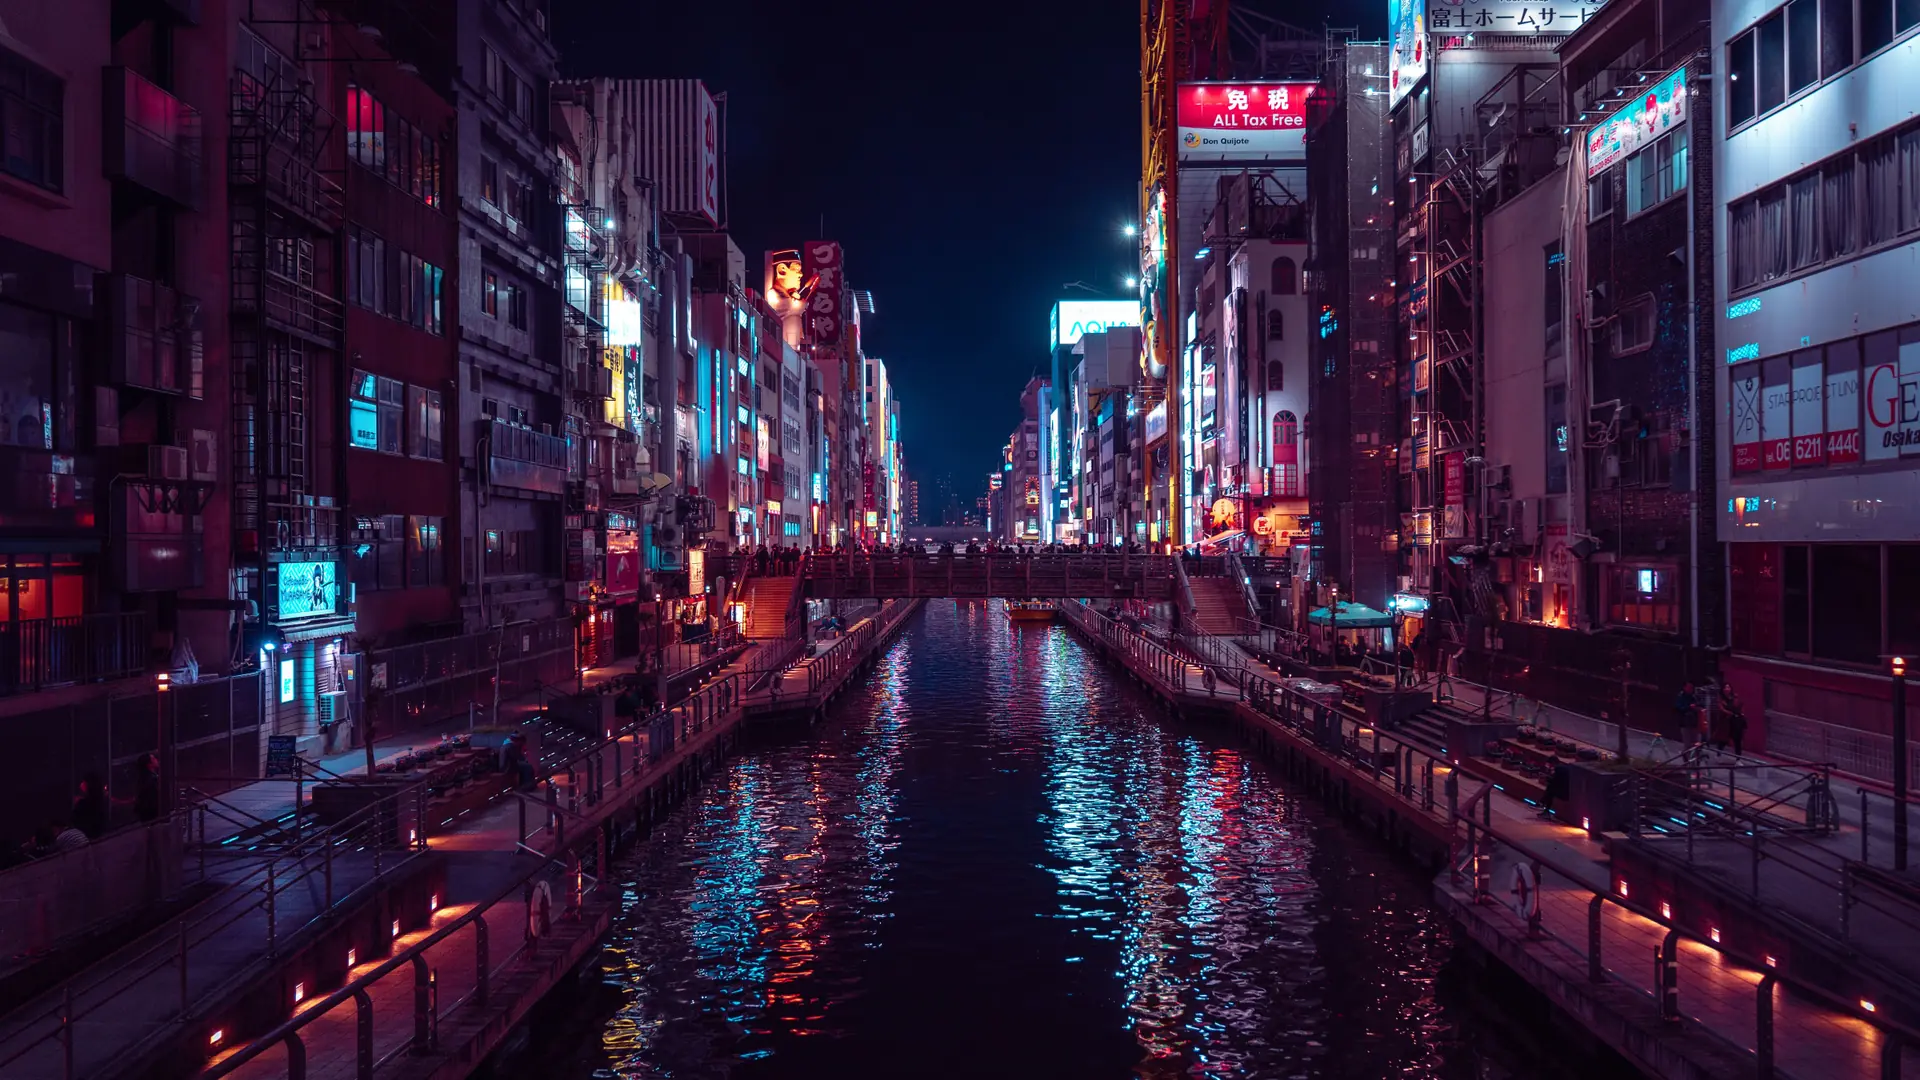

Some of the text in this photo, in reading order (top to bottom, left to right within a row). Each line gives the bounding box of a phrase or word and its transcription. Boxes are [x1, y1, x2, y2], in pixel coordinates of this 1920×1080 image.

[1213, 114, 1304, 127] ALL Tax Free
[1203, 137, 1250, 147] Don Quijote
[1796, 437, 1821, 460] 6211
